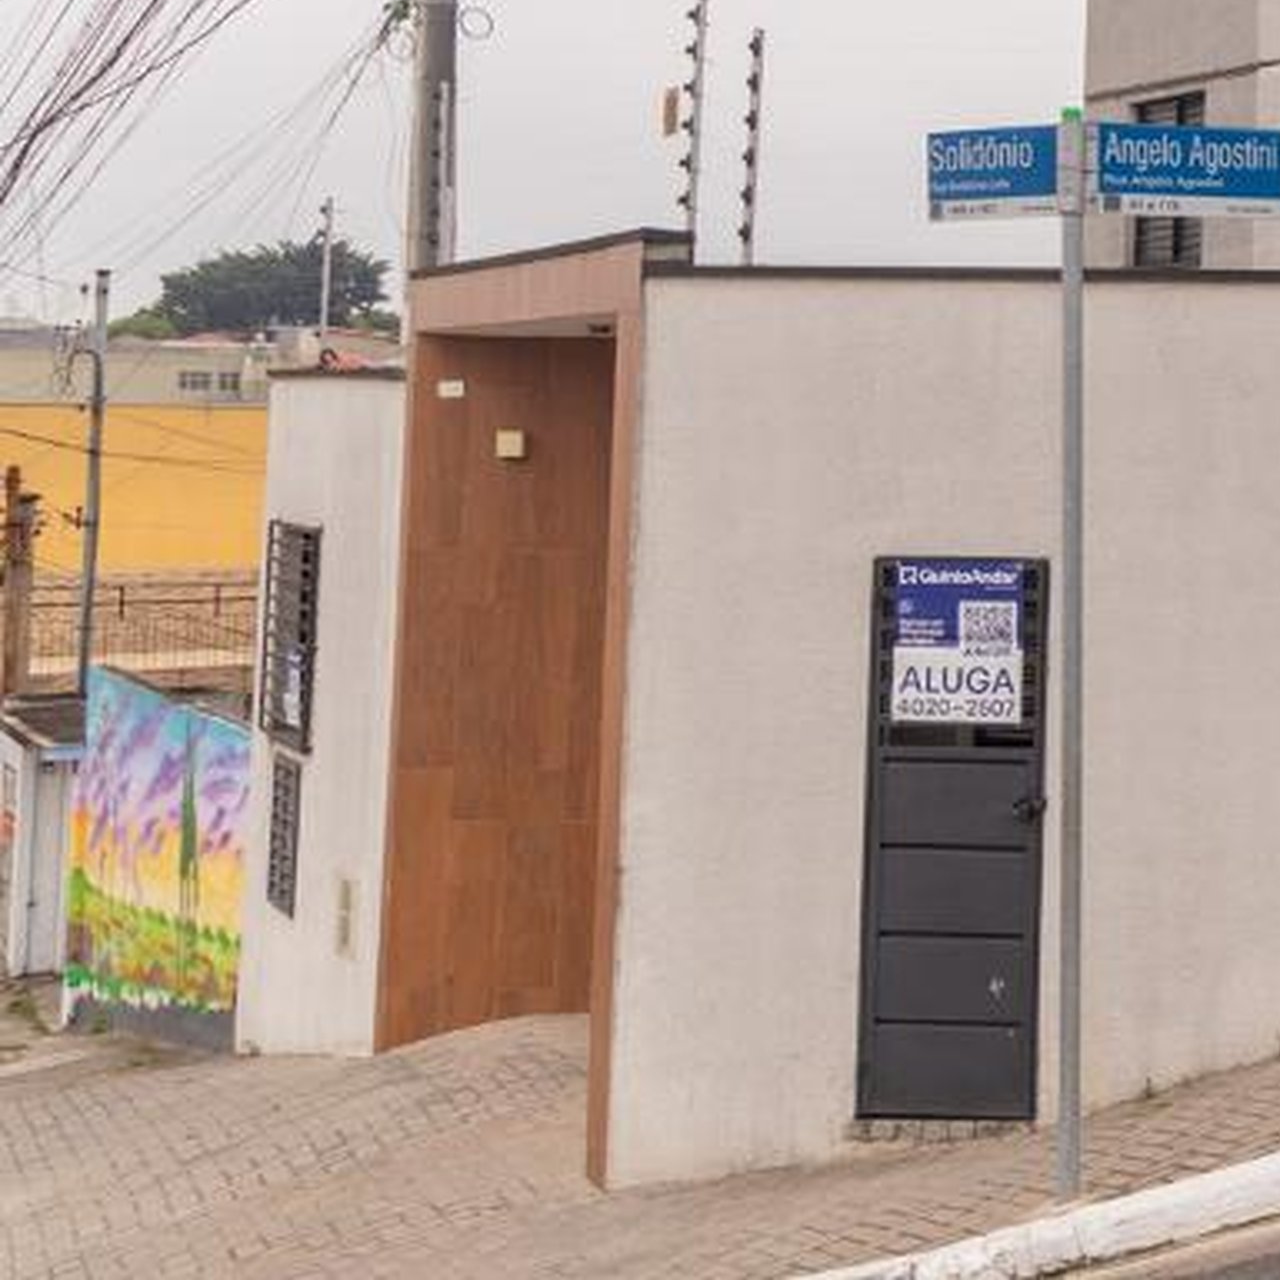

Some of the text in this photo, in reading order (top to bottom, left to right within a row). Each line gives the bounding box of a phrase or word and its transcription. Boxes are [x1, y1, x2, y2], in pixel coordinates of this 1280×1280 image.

[931, 134, 1033, 171] Solidônio
[1104, 132, 1278, 174] Angelo Agostini
[899, 666, 1014, 694] ALUGA
